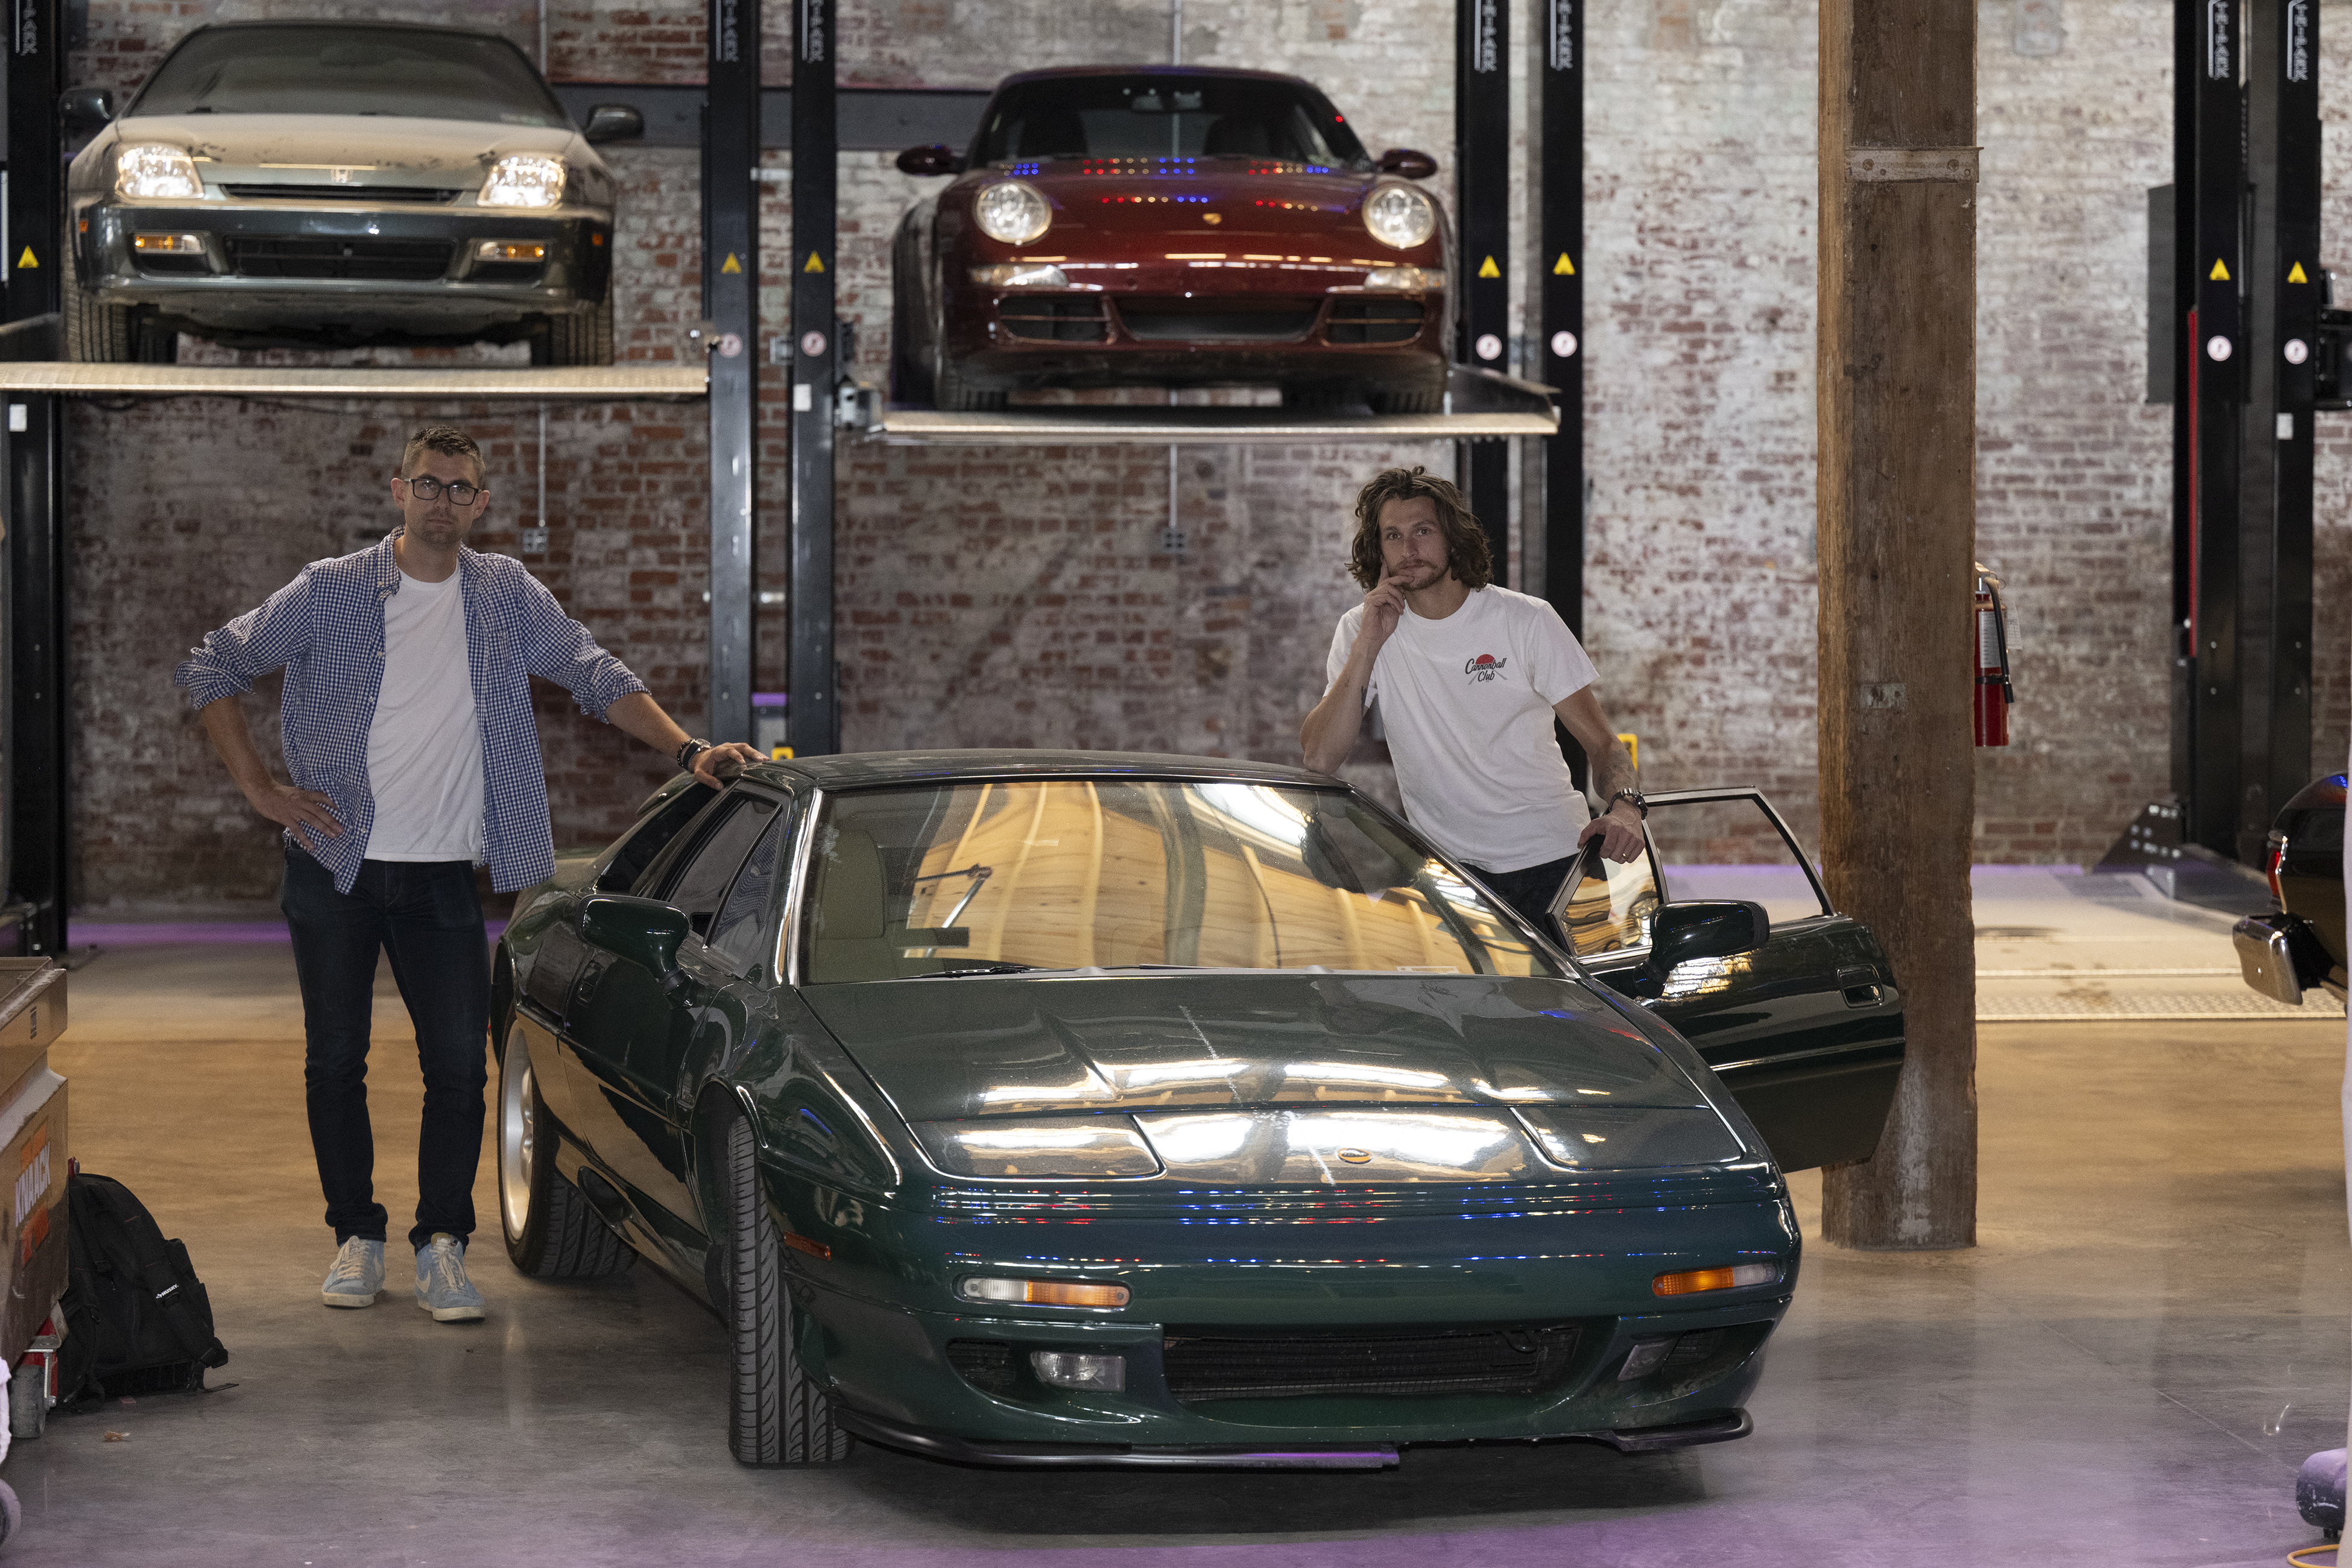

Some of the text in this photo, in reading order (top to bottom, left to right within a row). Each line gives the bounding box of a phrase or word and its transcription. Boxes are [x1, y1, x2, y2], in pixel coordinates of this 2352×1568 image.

[1557, 0, 1573, 71] RIPARK
[1465, 657, 1507, 675] Cannonball
[1478, 669, 1495, 682] Club
[15, 1141, 51, 1228] KNAACK
